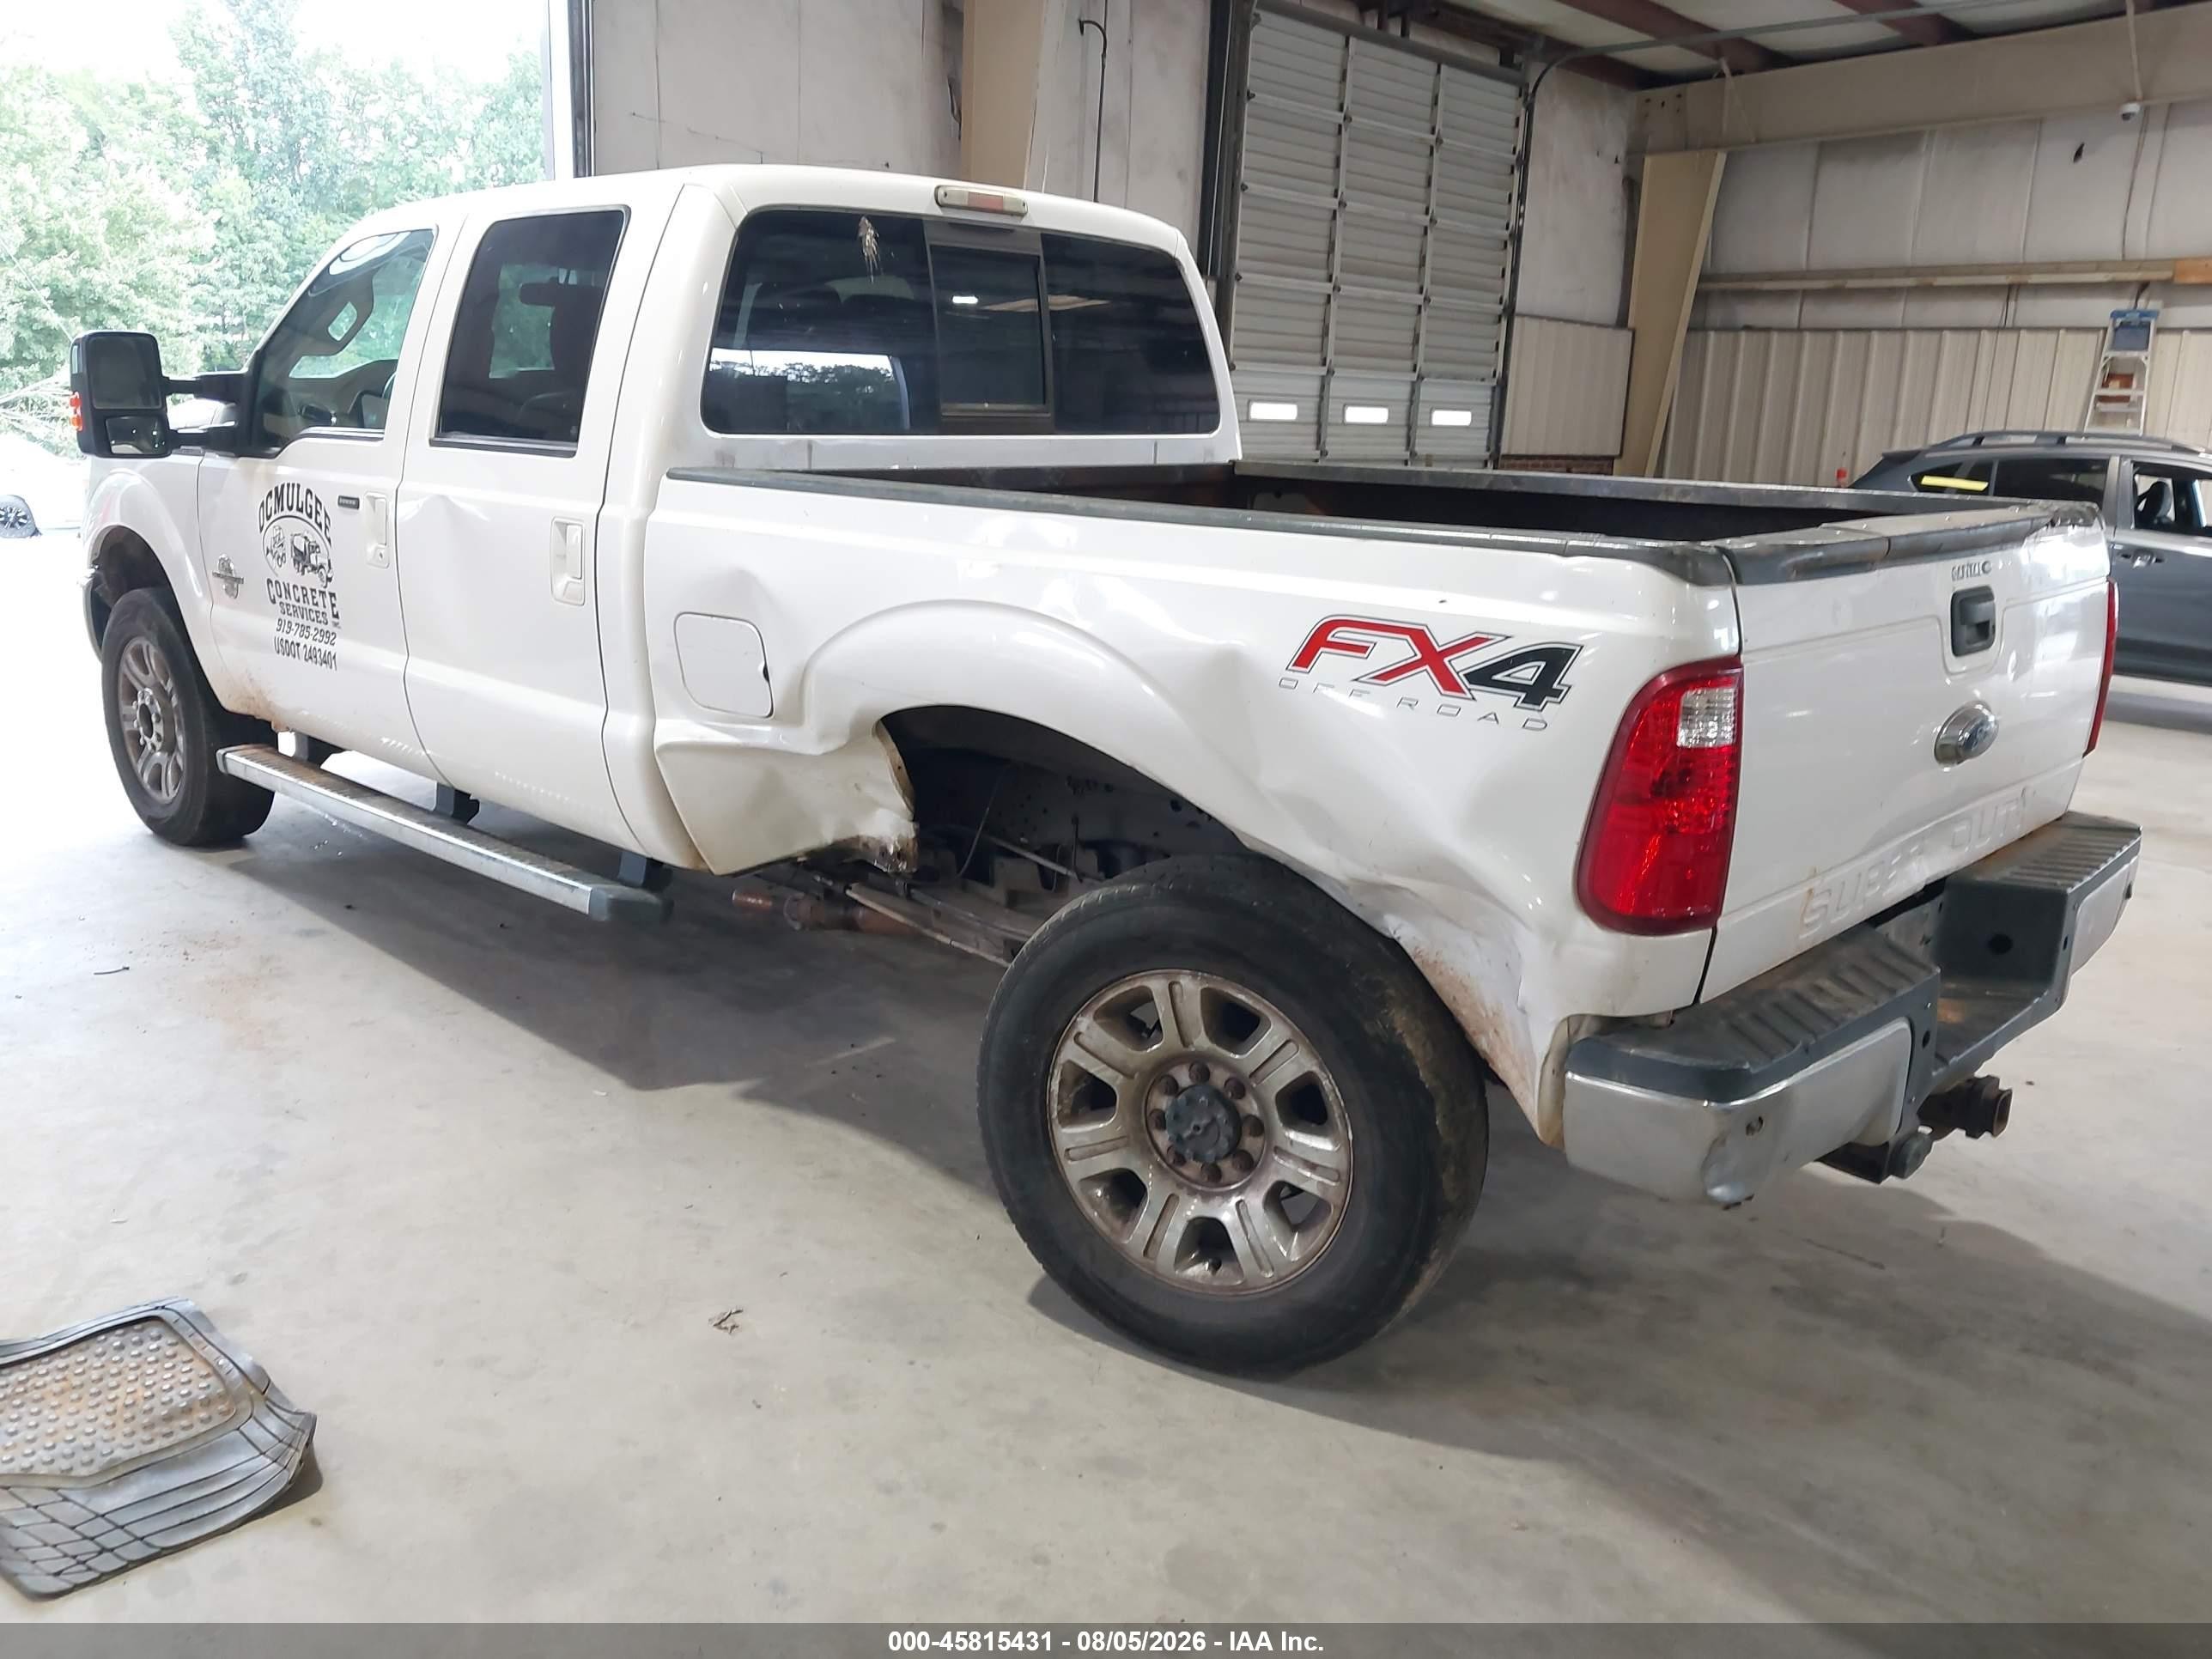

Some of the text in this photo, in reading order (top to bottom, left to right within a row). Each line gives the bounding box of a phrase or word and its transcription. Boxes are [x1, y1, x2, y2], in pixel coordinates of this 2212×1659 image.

[258, 483, 331, 548] OCMULGEE
[266, 578, 339, 619] CONCRETE
[279, 601, 329, 625] SERVICES
[276, 618, 337, 646] 919-785-2992
[274, 636, 337, 671] USDOT 2493401
[1285, 614, 1584, 712] FX4
[1395, 696, 1548, 732] ROAD
